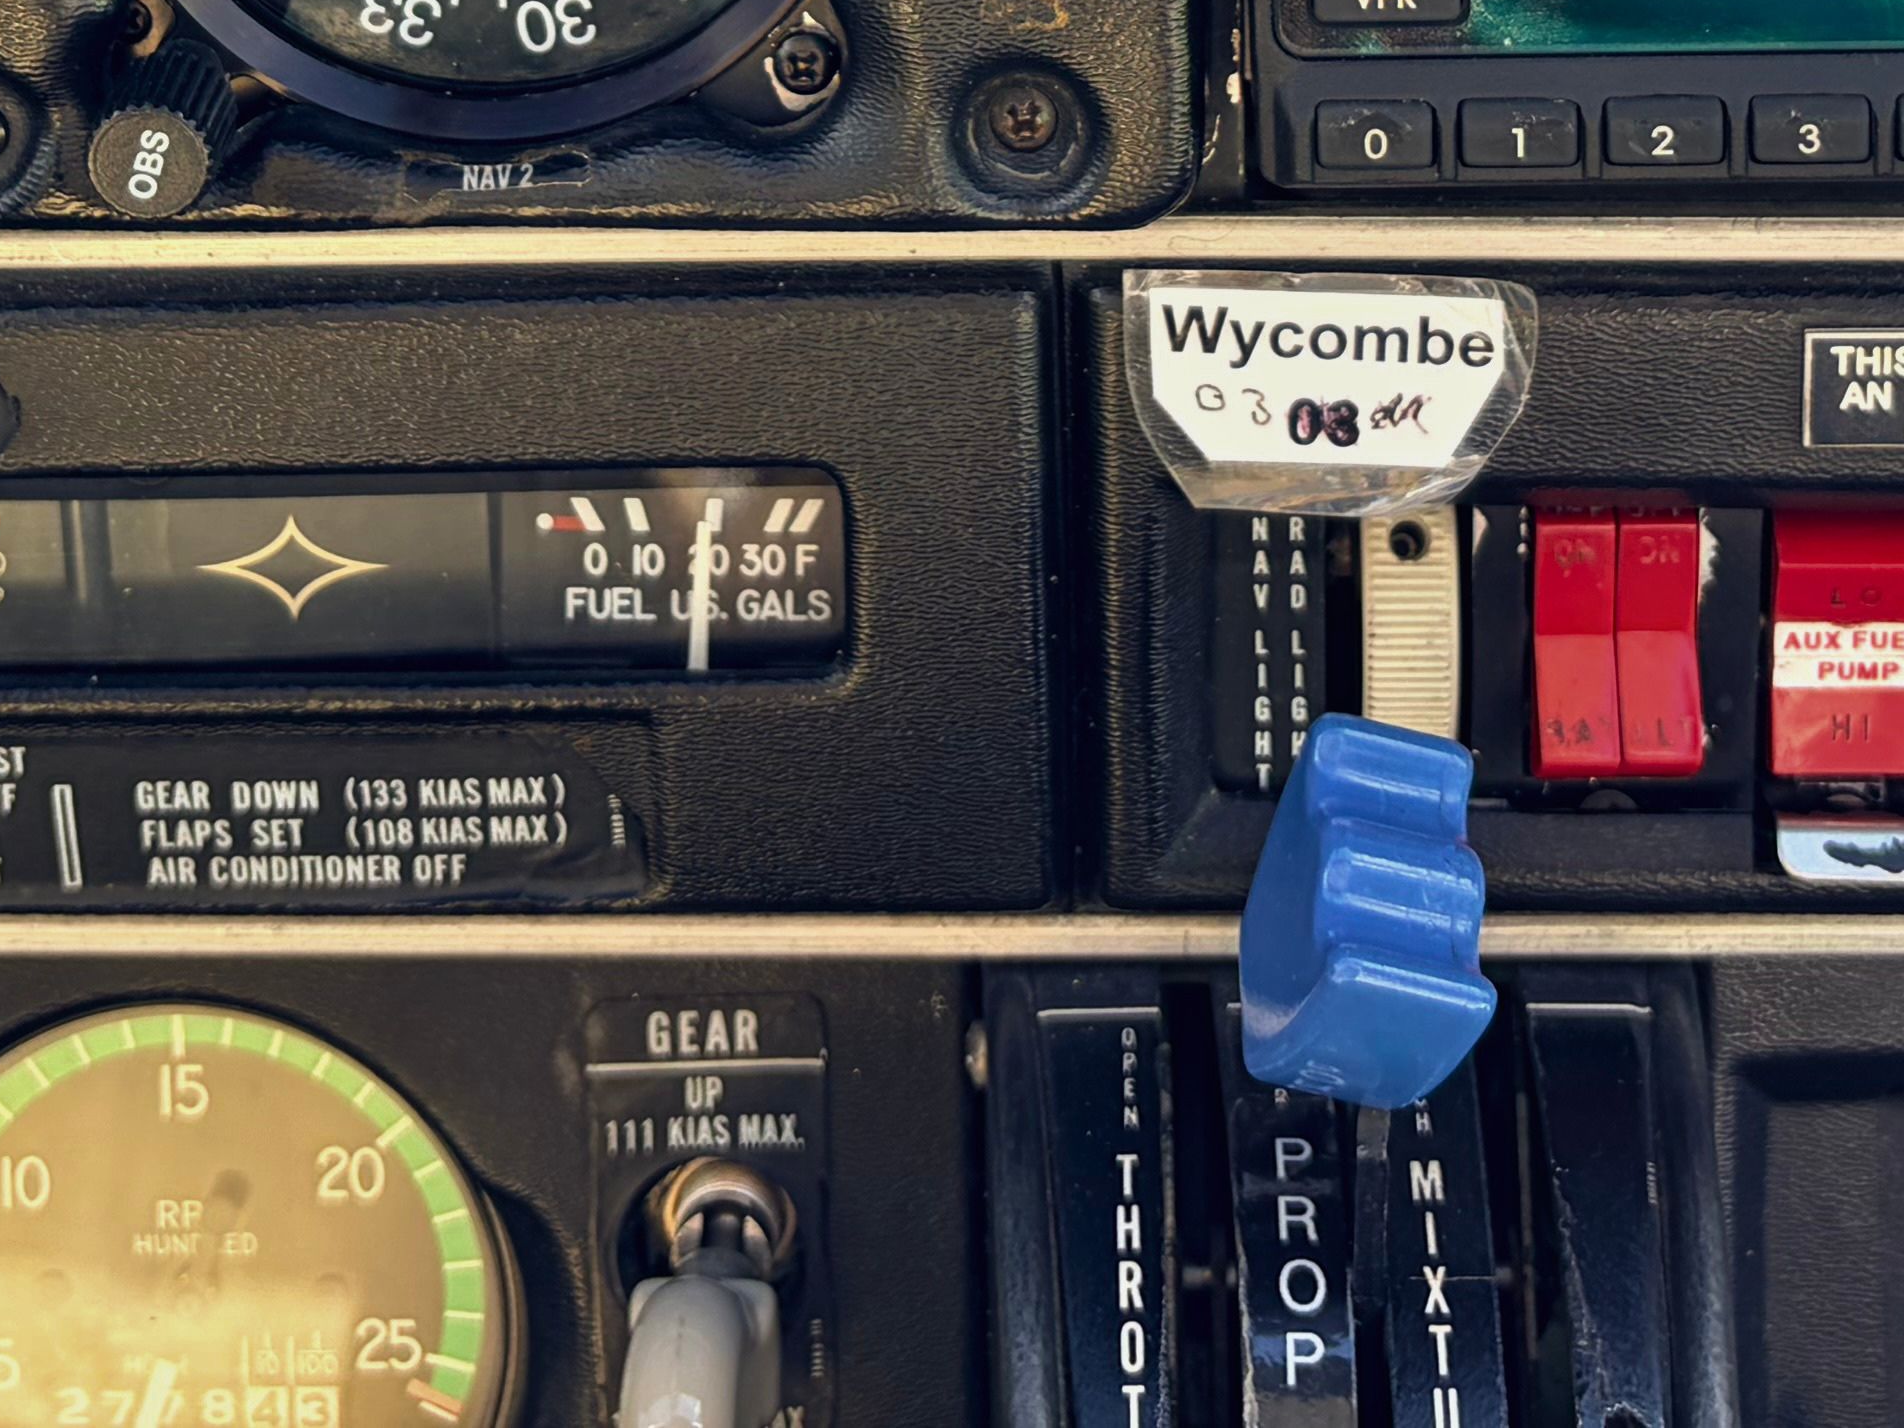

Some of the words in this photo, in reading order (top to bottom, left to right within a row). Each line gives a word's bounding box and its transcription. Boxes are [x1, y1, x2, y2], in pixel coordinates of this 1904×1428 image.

[126, 128, 171, 201] OBS
[1161, 304, 1496, 369] Wycombe
[1784, 630, 1842, 651] AUX
[1817, 661, 1902, 681] PUMP
[147, 854, 196, 888] AIR
[209, 853, 401, 887] CONDITIONER
[413, 853, 467, 886] OFF
[647, 1009, 760, 1056] GEAR
[157, 1064, 210, 1120] 15
[685, 1076, 724, 1112] UP
[0, 1154, 51, 1211] 10
[1274, 1137, 1328, 1387] PROP
